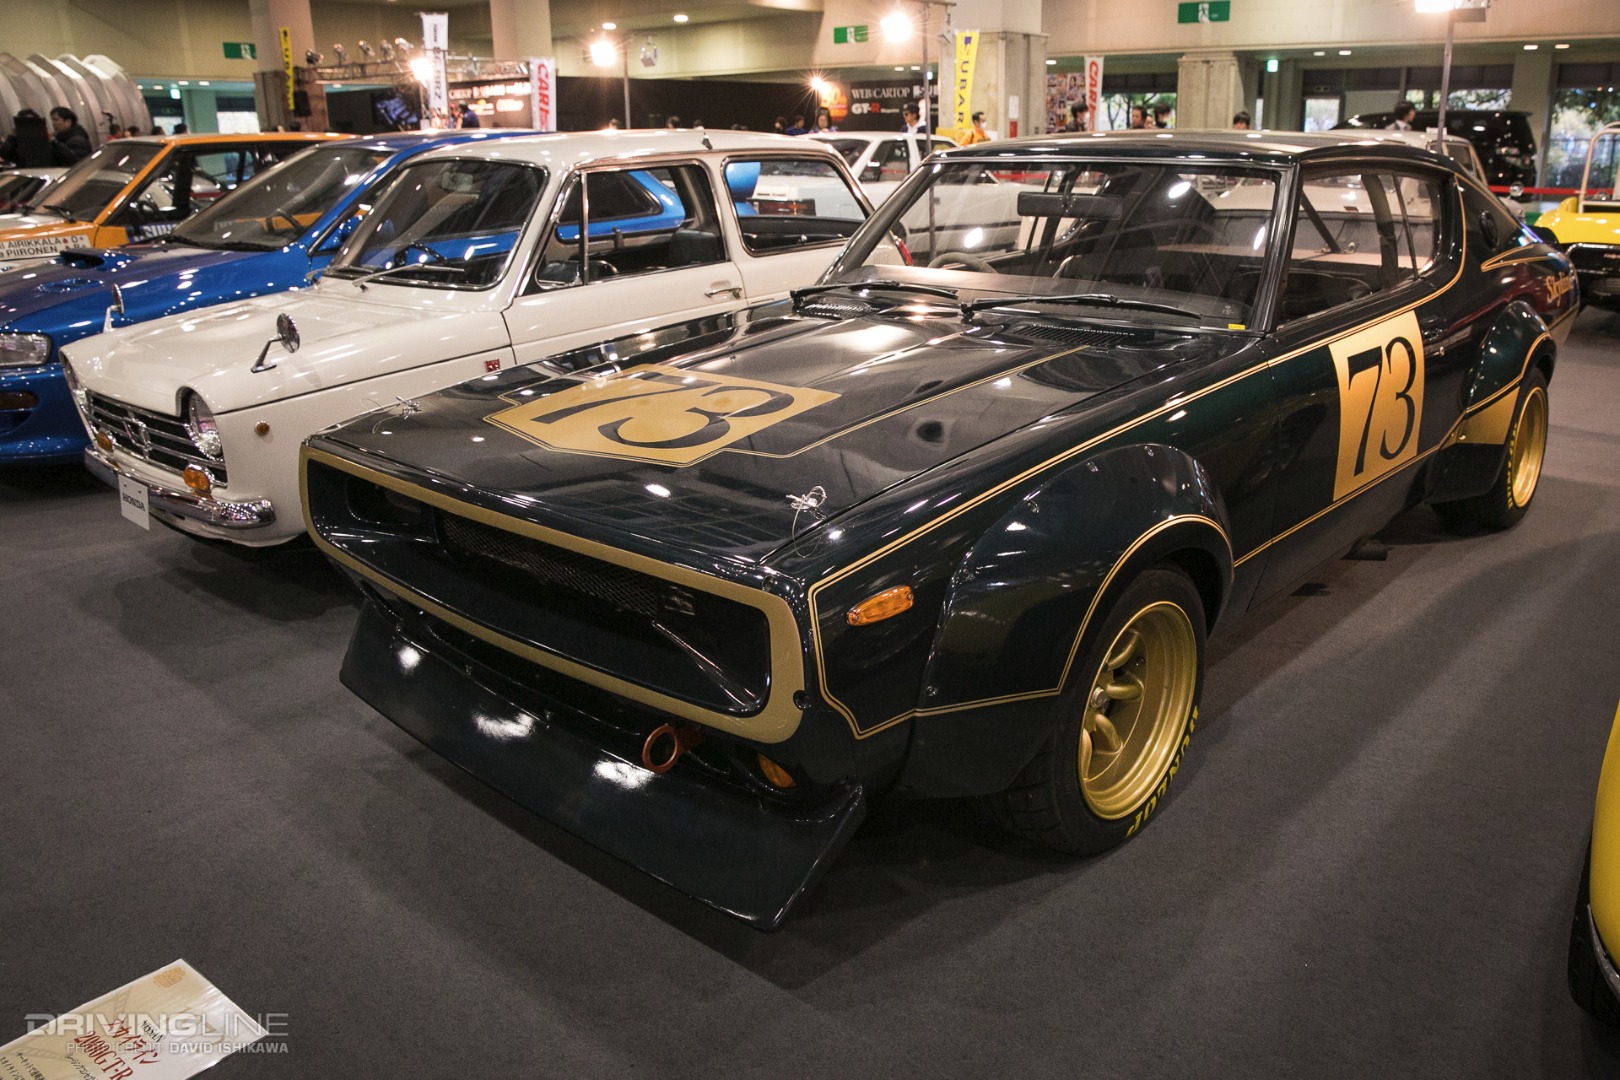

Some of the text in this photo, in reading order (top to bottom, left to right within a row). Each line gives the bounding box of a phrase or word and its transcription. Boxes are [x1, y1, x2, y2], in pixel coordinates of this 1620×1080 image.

[6, 245, 58, 258] PIIRONEN
[8, 237, 62, 249] AIRIKKALA
[531, 371, 795, 450] 73
[1346, 336, 1417, 477] 73
[122, 493, 146, 512] HONDA
[139, 1019, 166, 1043] NISSAN
